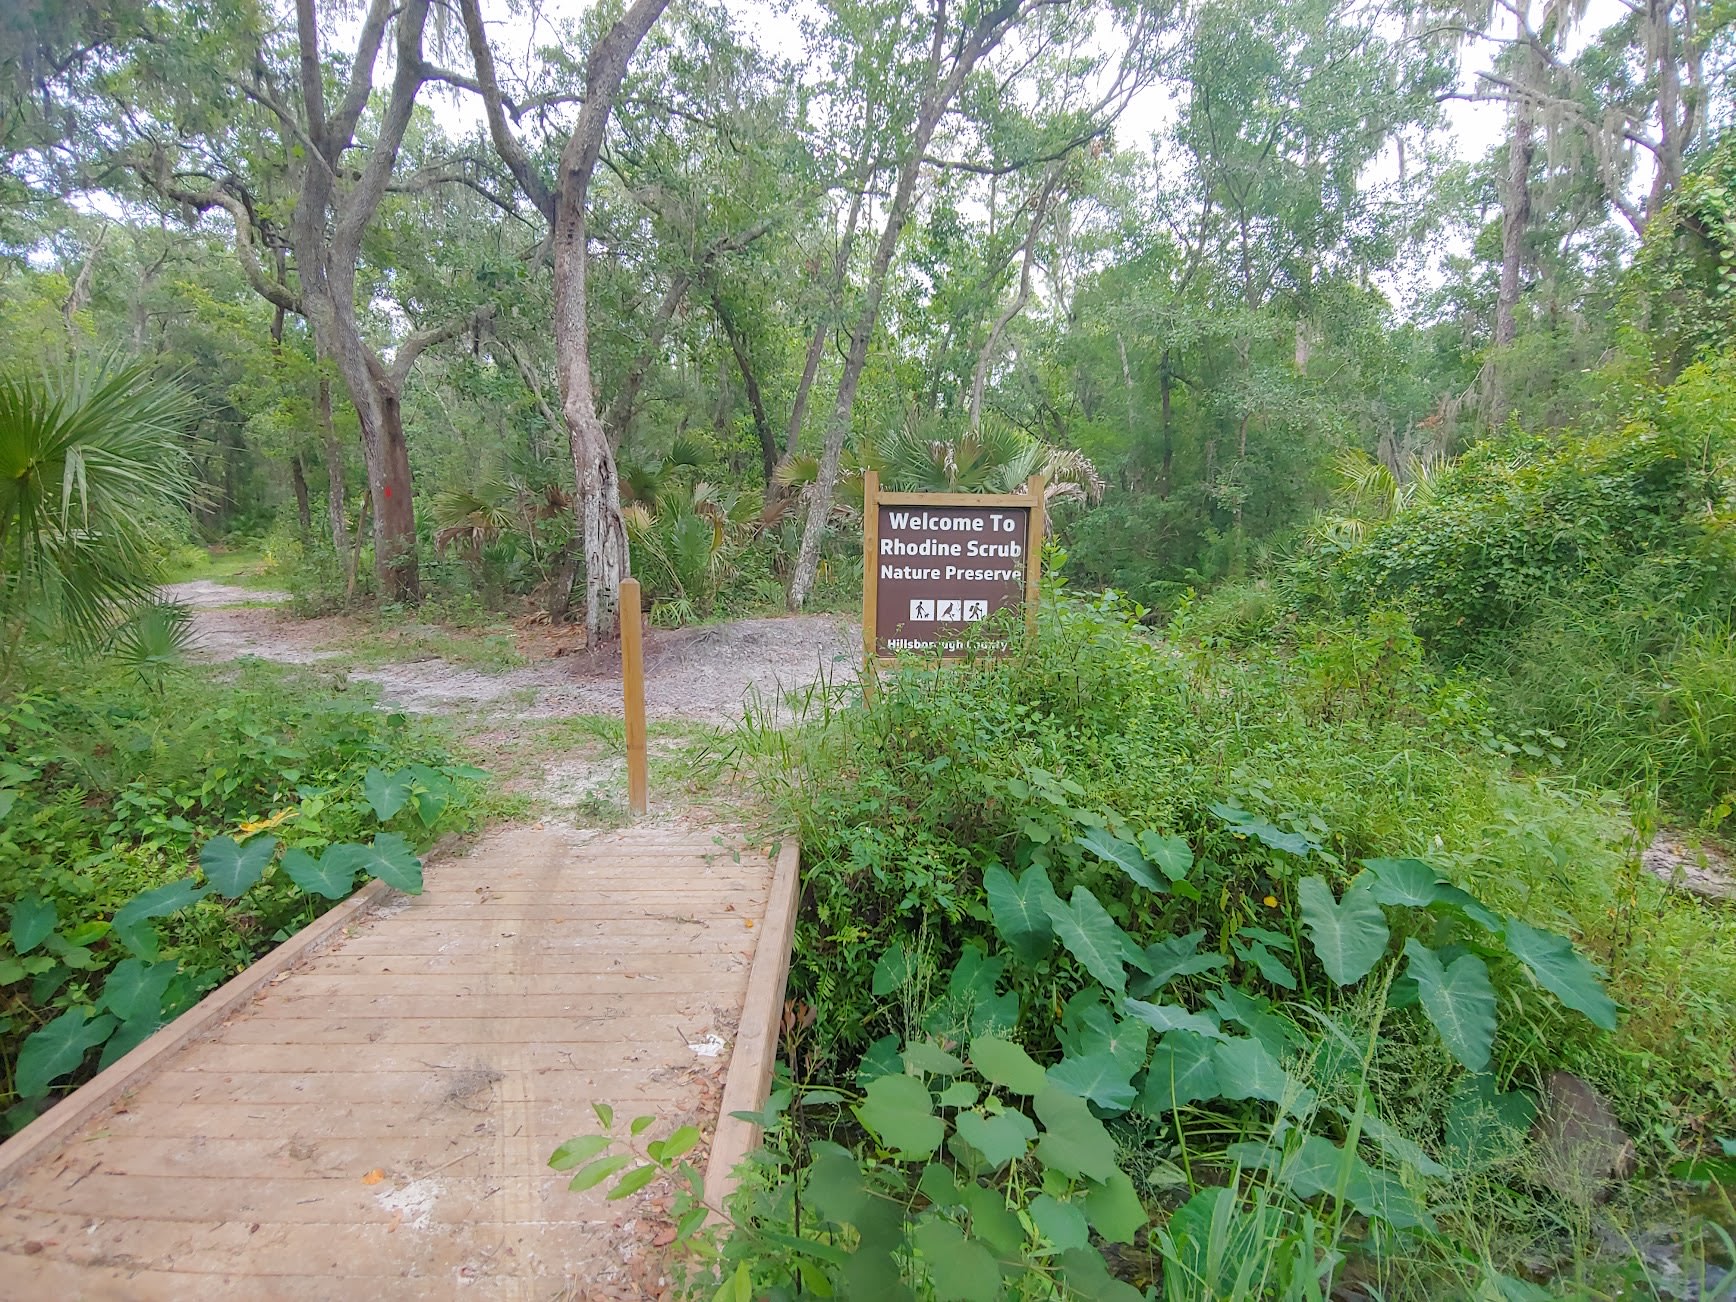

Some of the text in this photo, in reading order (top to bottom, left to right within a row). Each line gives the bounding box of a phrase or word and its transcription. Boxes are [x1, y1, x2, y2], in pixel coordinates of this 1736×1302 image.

[889, 512, 1015, 532] Welcome To
[881, 538, 1022, 557] Rhodine Scrub
[881, 565, 1021, 581] Nature Preserve
[887, 639, 963, 651] Hillsborugh
